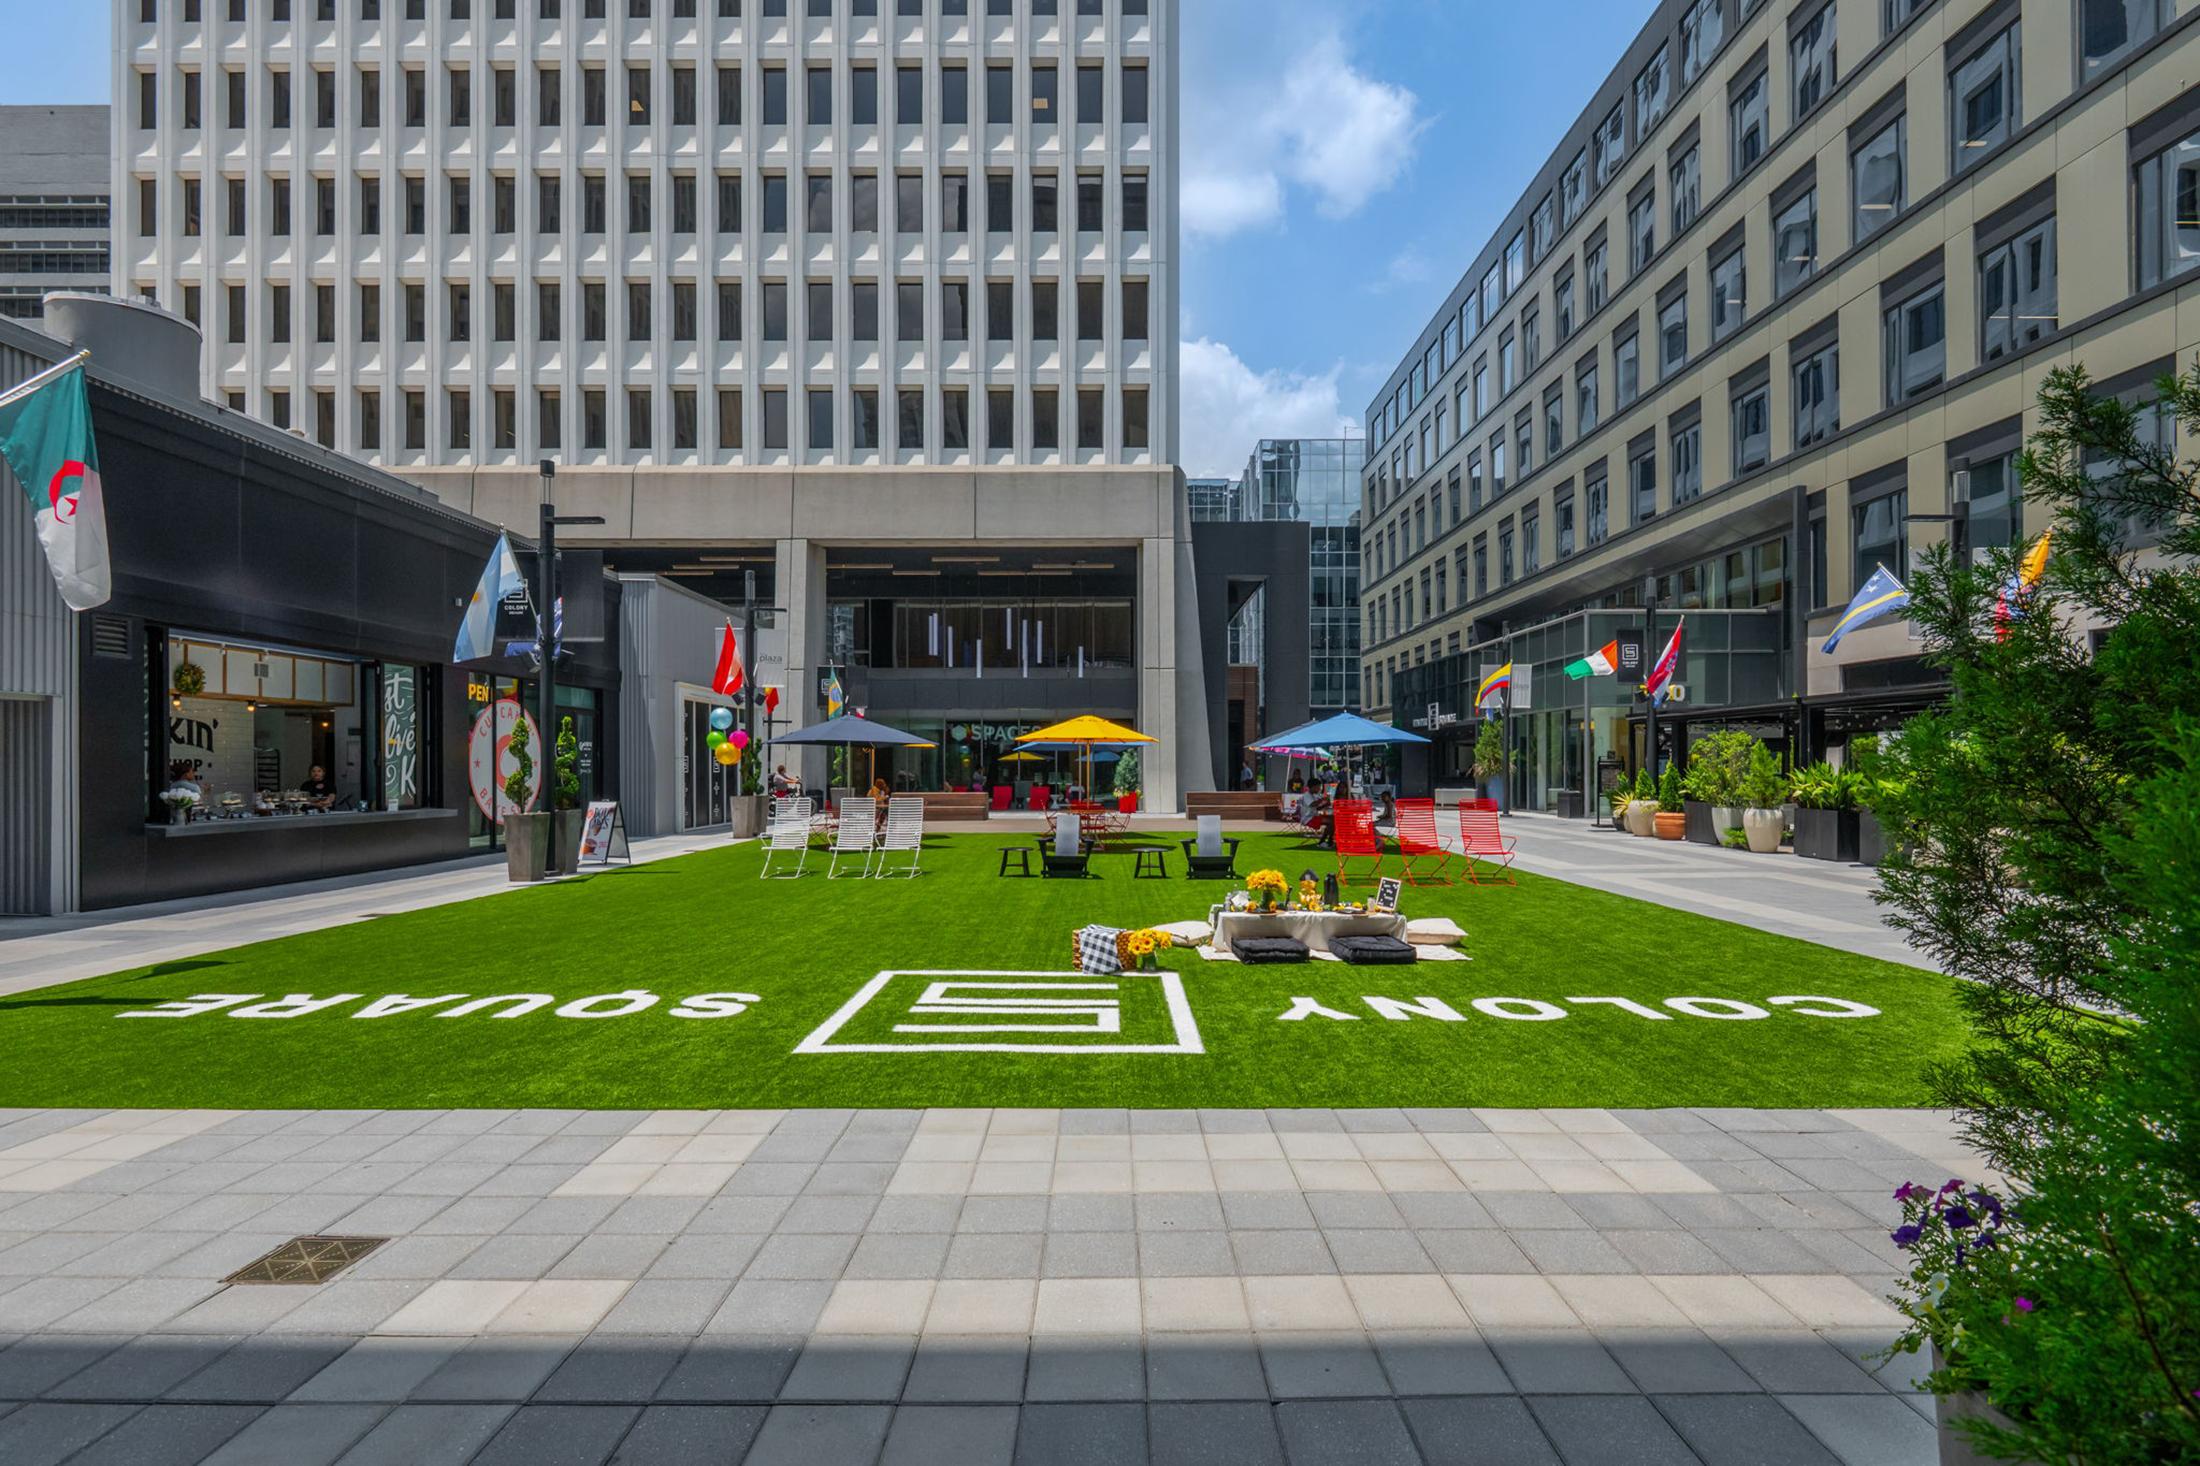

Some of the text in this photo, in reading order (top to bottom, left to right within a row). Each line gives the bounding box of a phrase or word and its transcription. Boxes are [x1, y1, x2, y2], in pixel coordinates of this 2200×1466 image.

[759, 654, 783, 663] plaza
[114, 990, 1882, 1021] COLONY SQUARE
